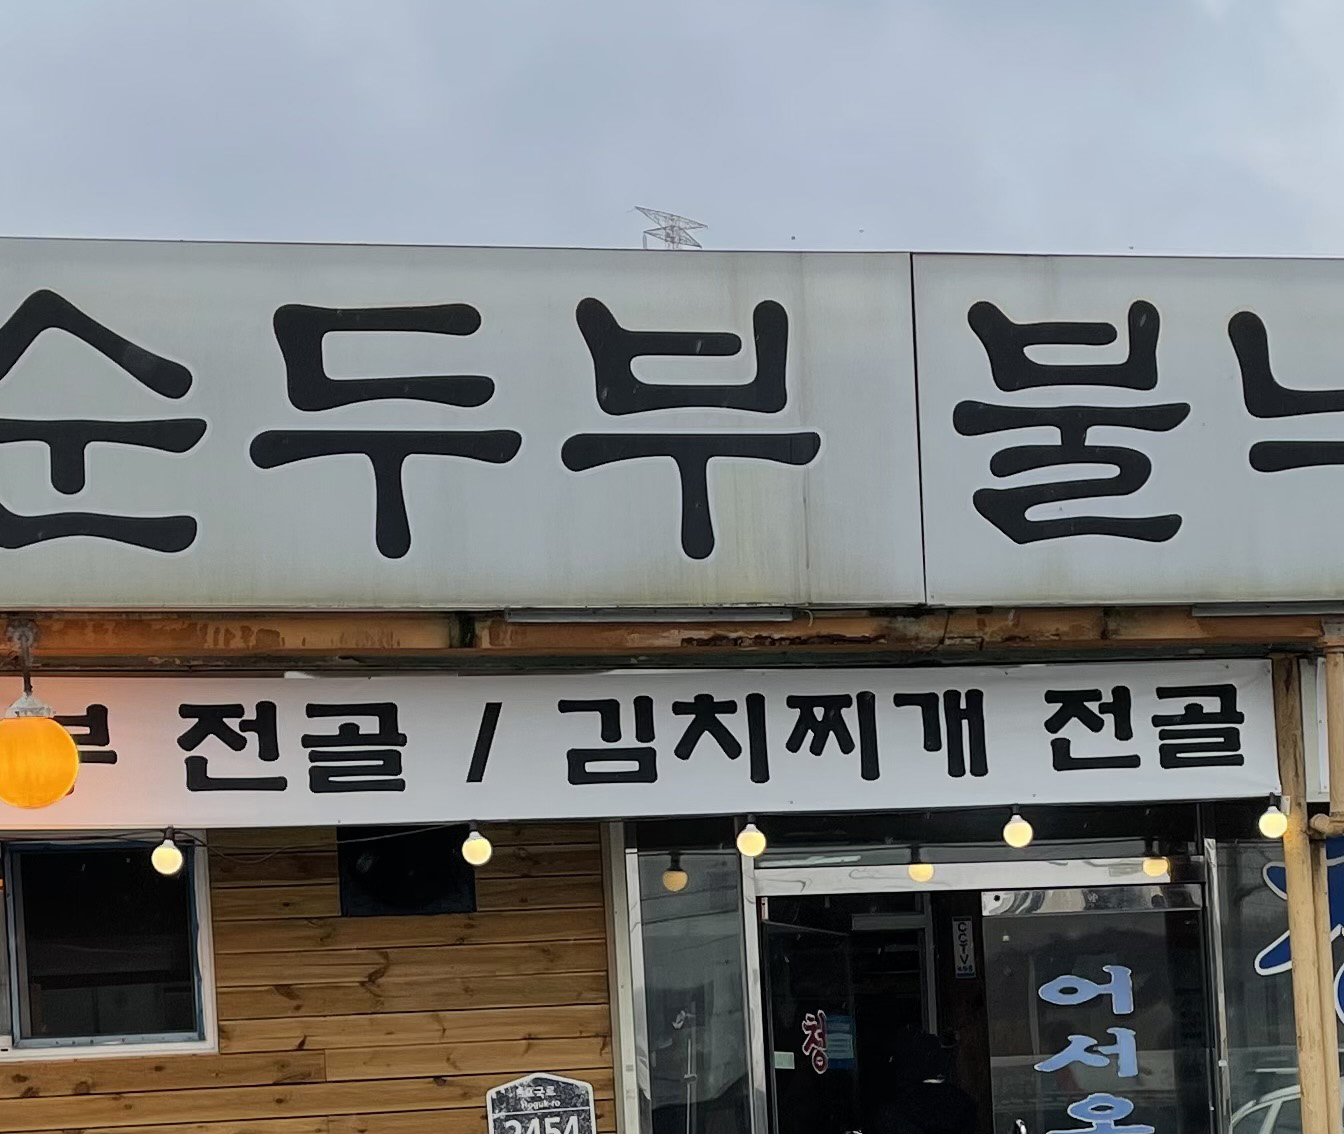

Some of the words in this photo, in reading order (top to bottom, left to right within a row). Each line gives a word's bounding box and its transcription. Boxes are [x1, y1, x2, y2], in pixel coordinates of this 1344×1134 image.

[177, 701, 407, 793] 전골
[558, 690, 988, 785] 김치찌개
[1044, 684, 1244, 771] 전골
[958, 922, 969, 964] CCTV
